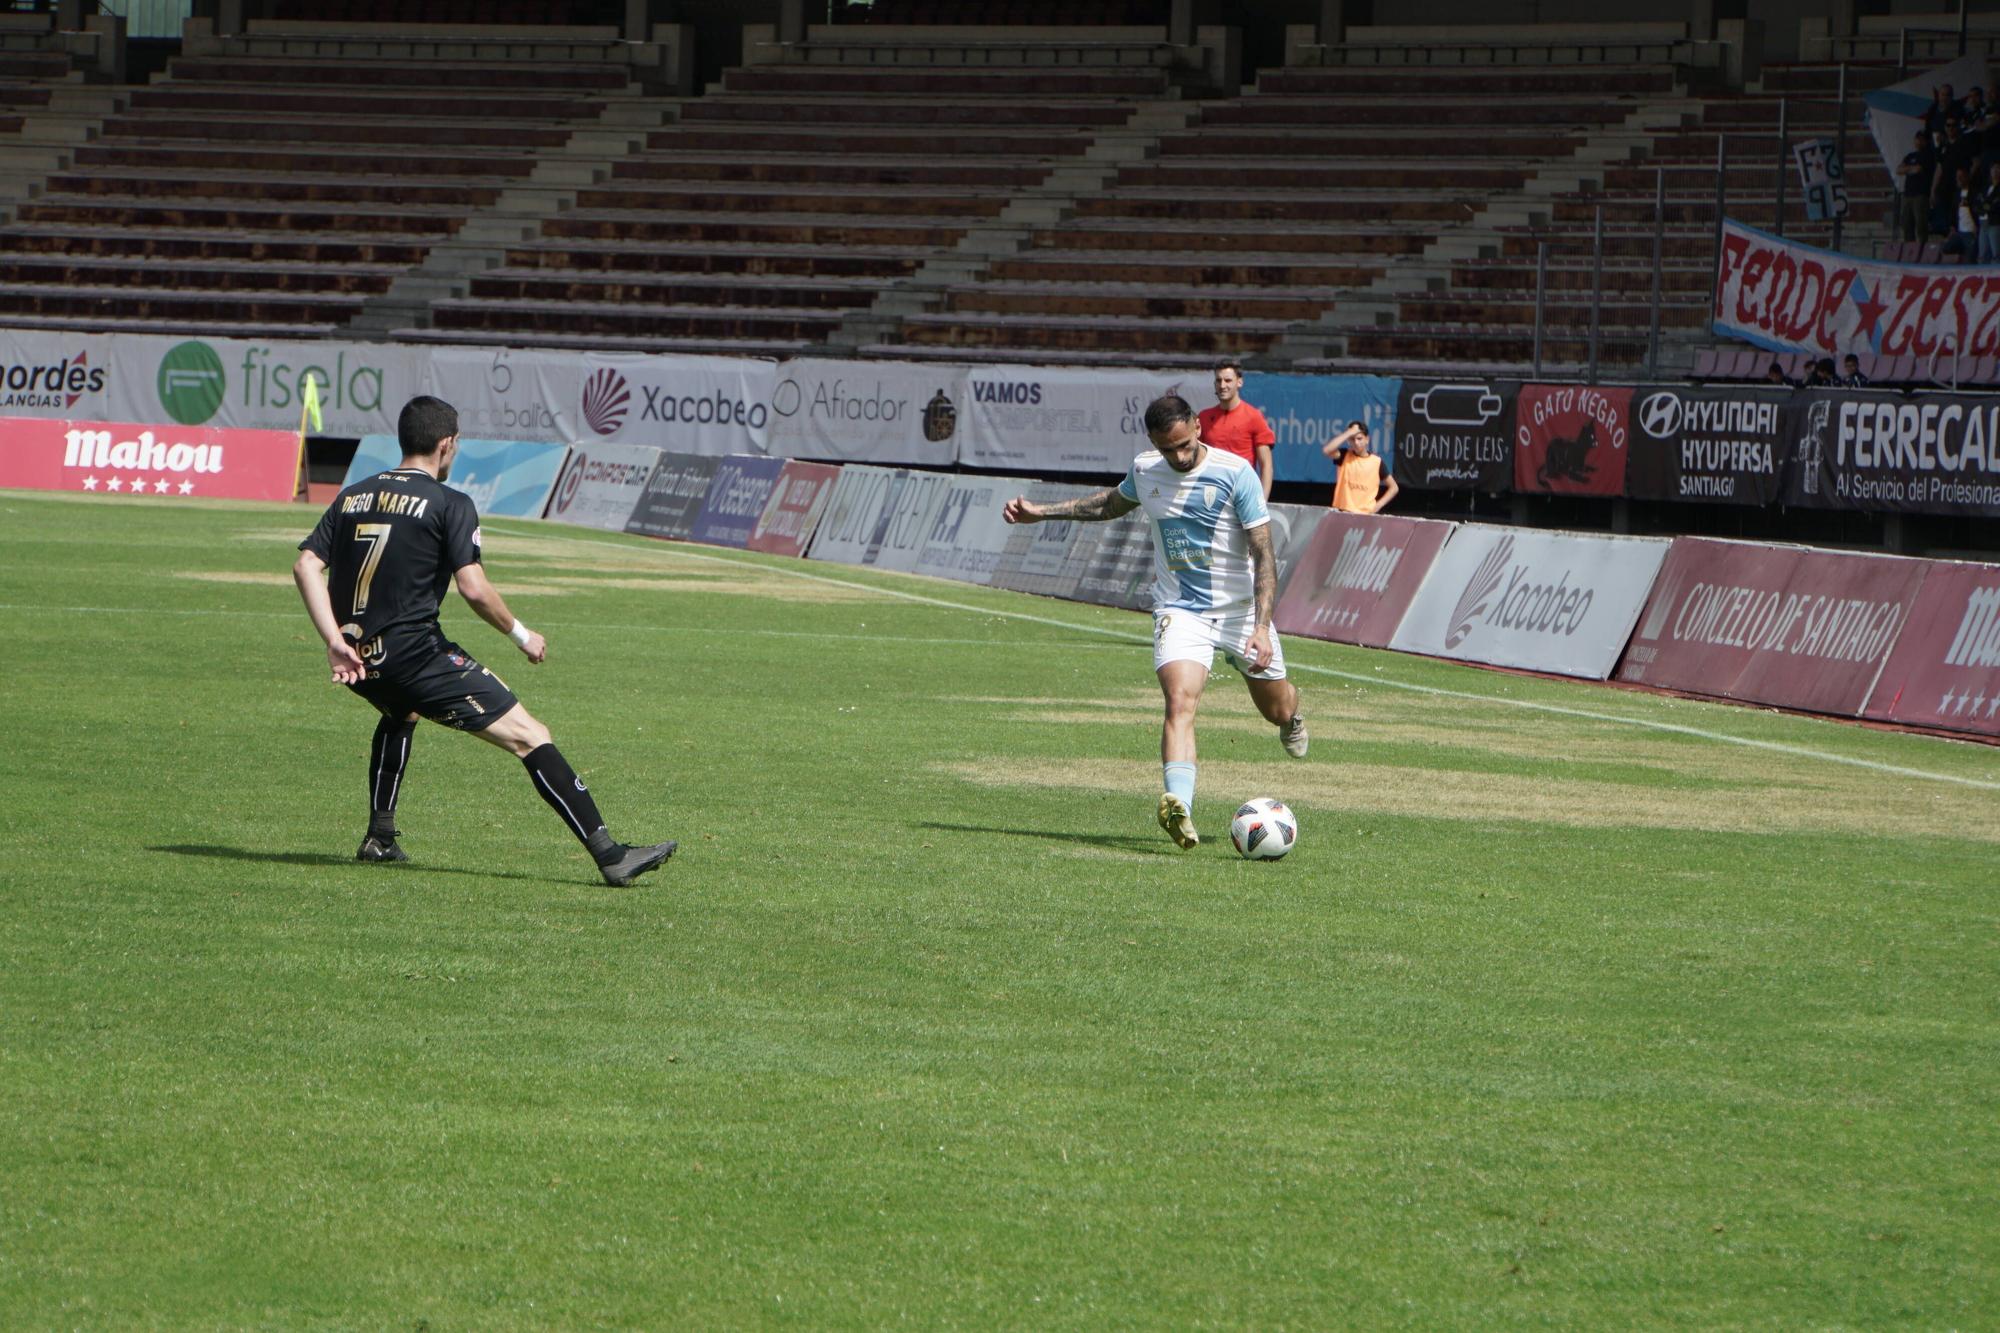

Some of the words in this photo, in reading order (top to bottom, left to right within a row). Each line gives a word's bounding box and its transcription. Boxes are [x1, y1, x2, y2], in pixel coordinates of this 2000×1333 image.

[0, 349, 105, 393] ordés
[240, 346, 384, 413] fisela
[0, 394, 63, 408] ANCIAS
[640, 385, 767, 430] Xacobeo
[772, 379, 801, 417] O
[809, 378, 907, 422] Afiador
[972, 380, 1043, 406] VAMOS
[1122, 395, 1140, 414] AS
[1518, 424, 1532, 448] O
[1533, 387, 1573, 428] GATO
[1577, 388, 1626, 449] NEGRO
[1682, 399, 1779, 436] HYUNDAI
[63, 428, 224, 474] Mahou
[1404, 432, 1416, 460] O
[1420, 434, 1452, 461] PAN
[1454, 435, 1471, 462] DE
[1475, 436, 1506, 463] LEIS
[1681, 439, 1774, 474] HYUPERSA
[341, 492, 375, 514] DIEGO
[376, 490, 430, 519] MARTA
[1679, 475, 1736, 498] SANTIAGO
[1853, 475, 1904, 501] Servicio
[1908, 478, 1927, 500] del
[883, 474, 948, 551] REY
[1166, 537, 1191, 549] San
[1168, 547, 1206, 561] Rafael
[1324, 527, 1402, 594] Mahou
[352, 522, 393, 616] 7
[1485, 564, 1595, 637] Xacobeo
[1672, 581, 1780, 650] CONCELLO
[1763, 591, 1804, 653] DE
[1790, 592, 1902, 664] SANTIAGO
